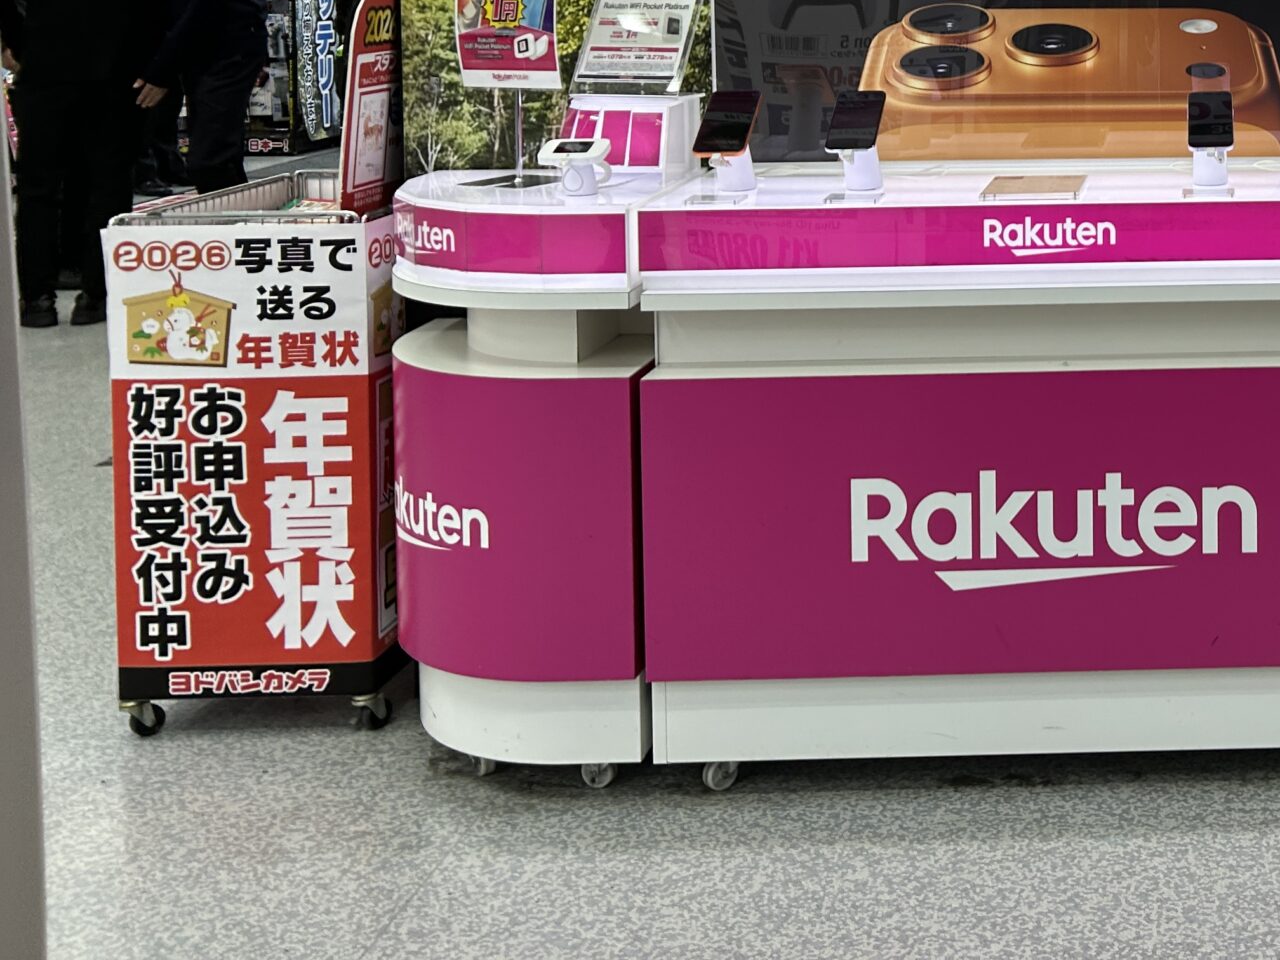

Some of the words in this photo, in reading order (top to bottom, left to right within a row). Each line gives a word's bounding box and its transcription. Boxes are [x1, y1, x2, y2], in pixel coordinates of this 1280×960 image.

[983, 218, 1117, 249] Rakuten
[113, 240, 232, 272] 2026
[234, 237, 357, 274] 写真で
[256, 285, 338, 322] 送る
[235, 331, 360, 370] 年賀状
[189, 384, 252, 604] お申込み
[128, 384, 191, 662] 好評受付中
[261, 389, 356, 651] 年賀状
[849, 472, 1258, 565] Rakuten
[168, 669, 331, 696] ヨドバシカメラ
